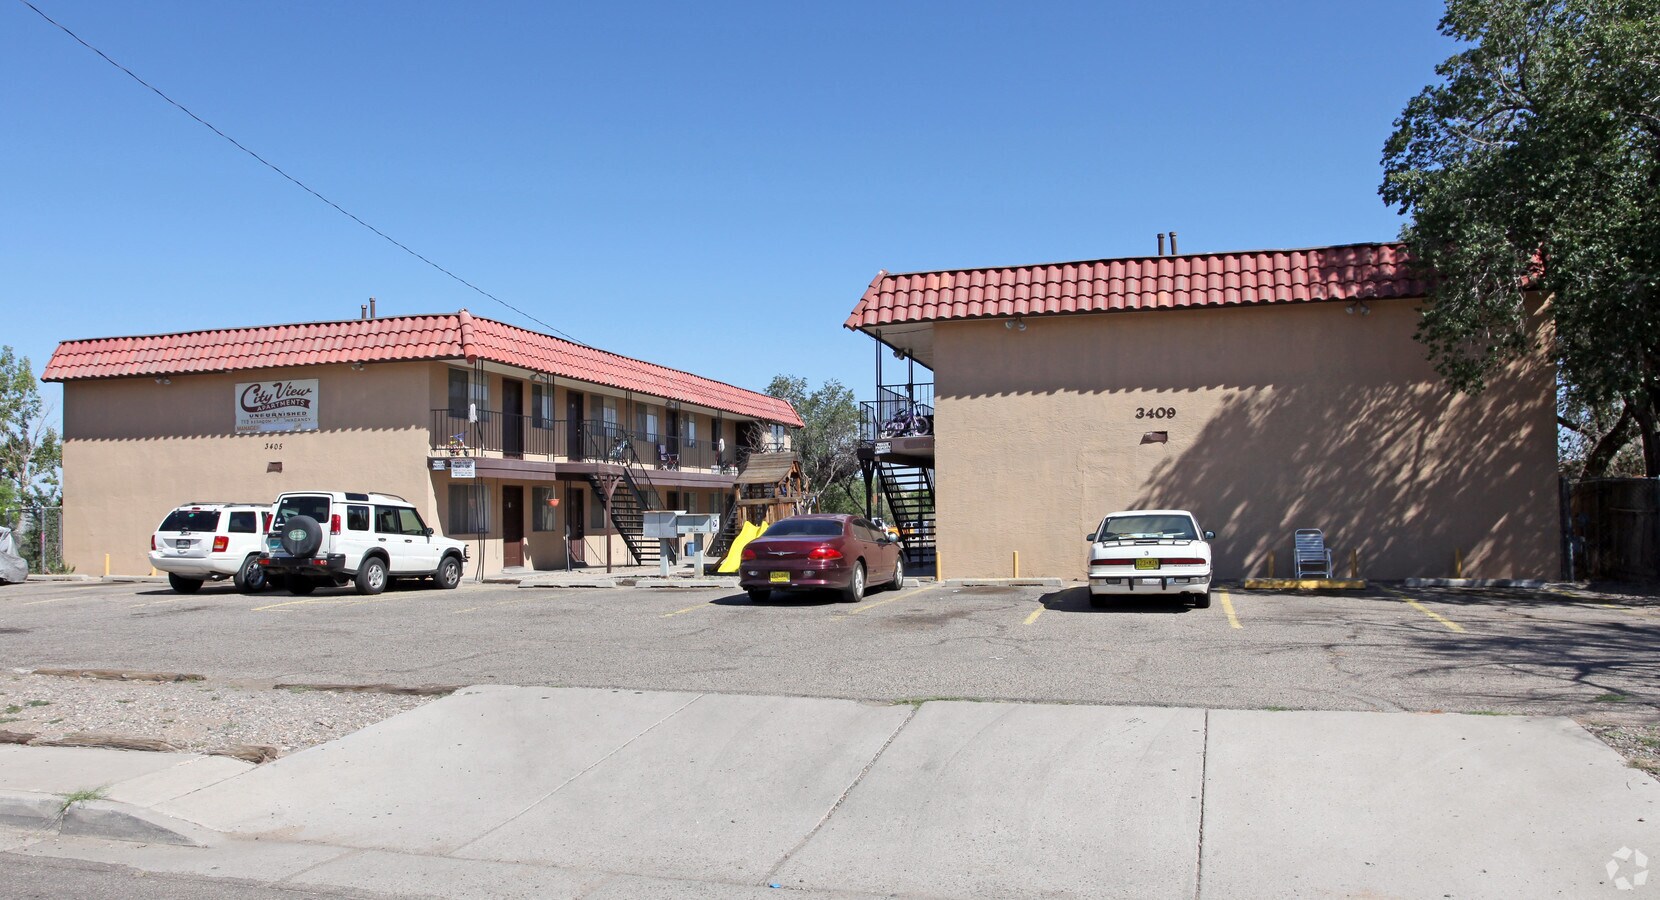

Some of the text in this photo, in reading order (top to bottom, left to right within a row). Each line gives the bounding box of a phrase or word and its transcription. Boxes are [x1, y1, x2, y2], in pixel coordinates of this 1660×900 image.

[241, 382, 312, 412] City View
[257, 399, 305, 412] APARTMENTS
[1135, 407, 1176, 419] 3409
